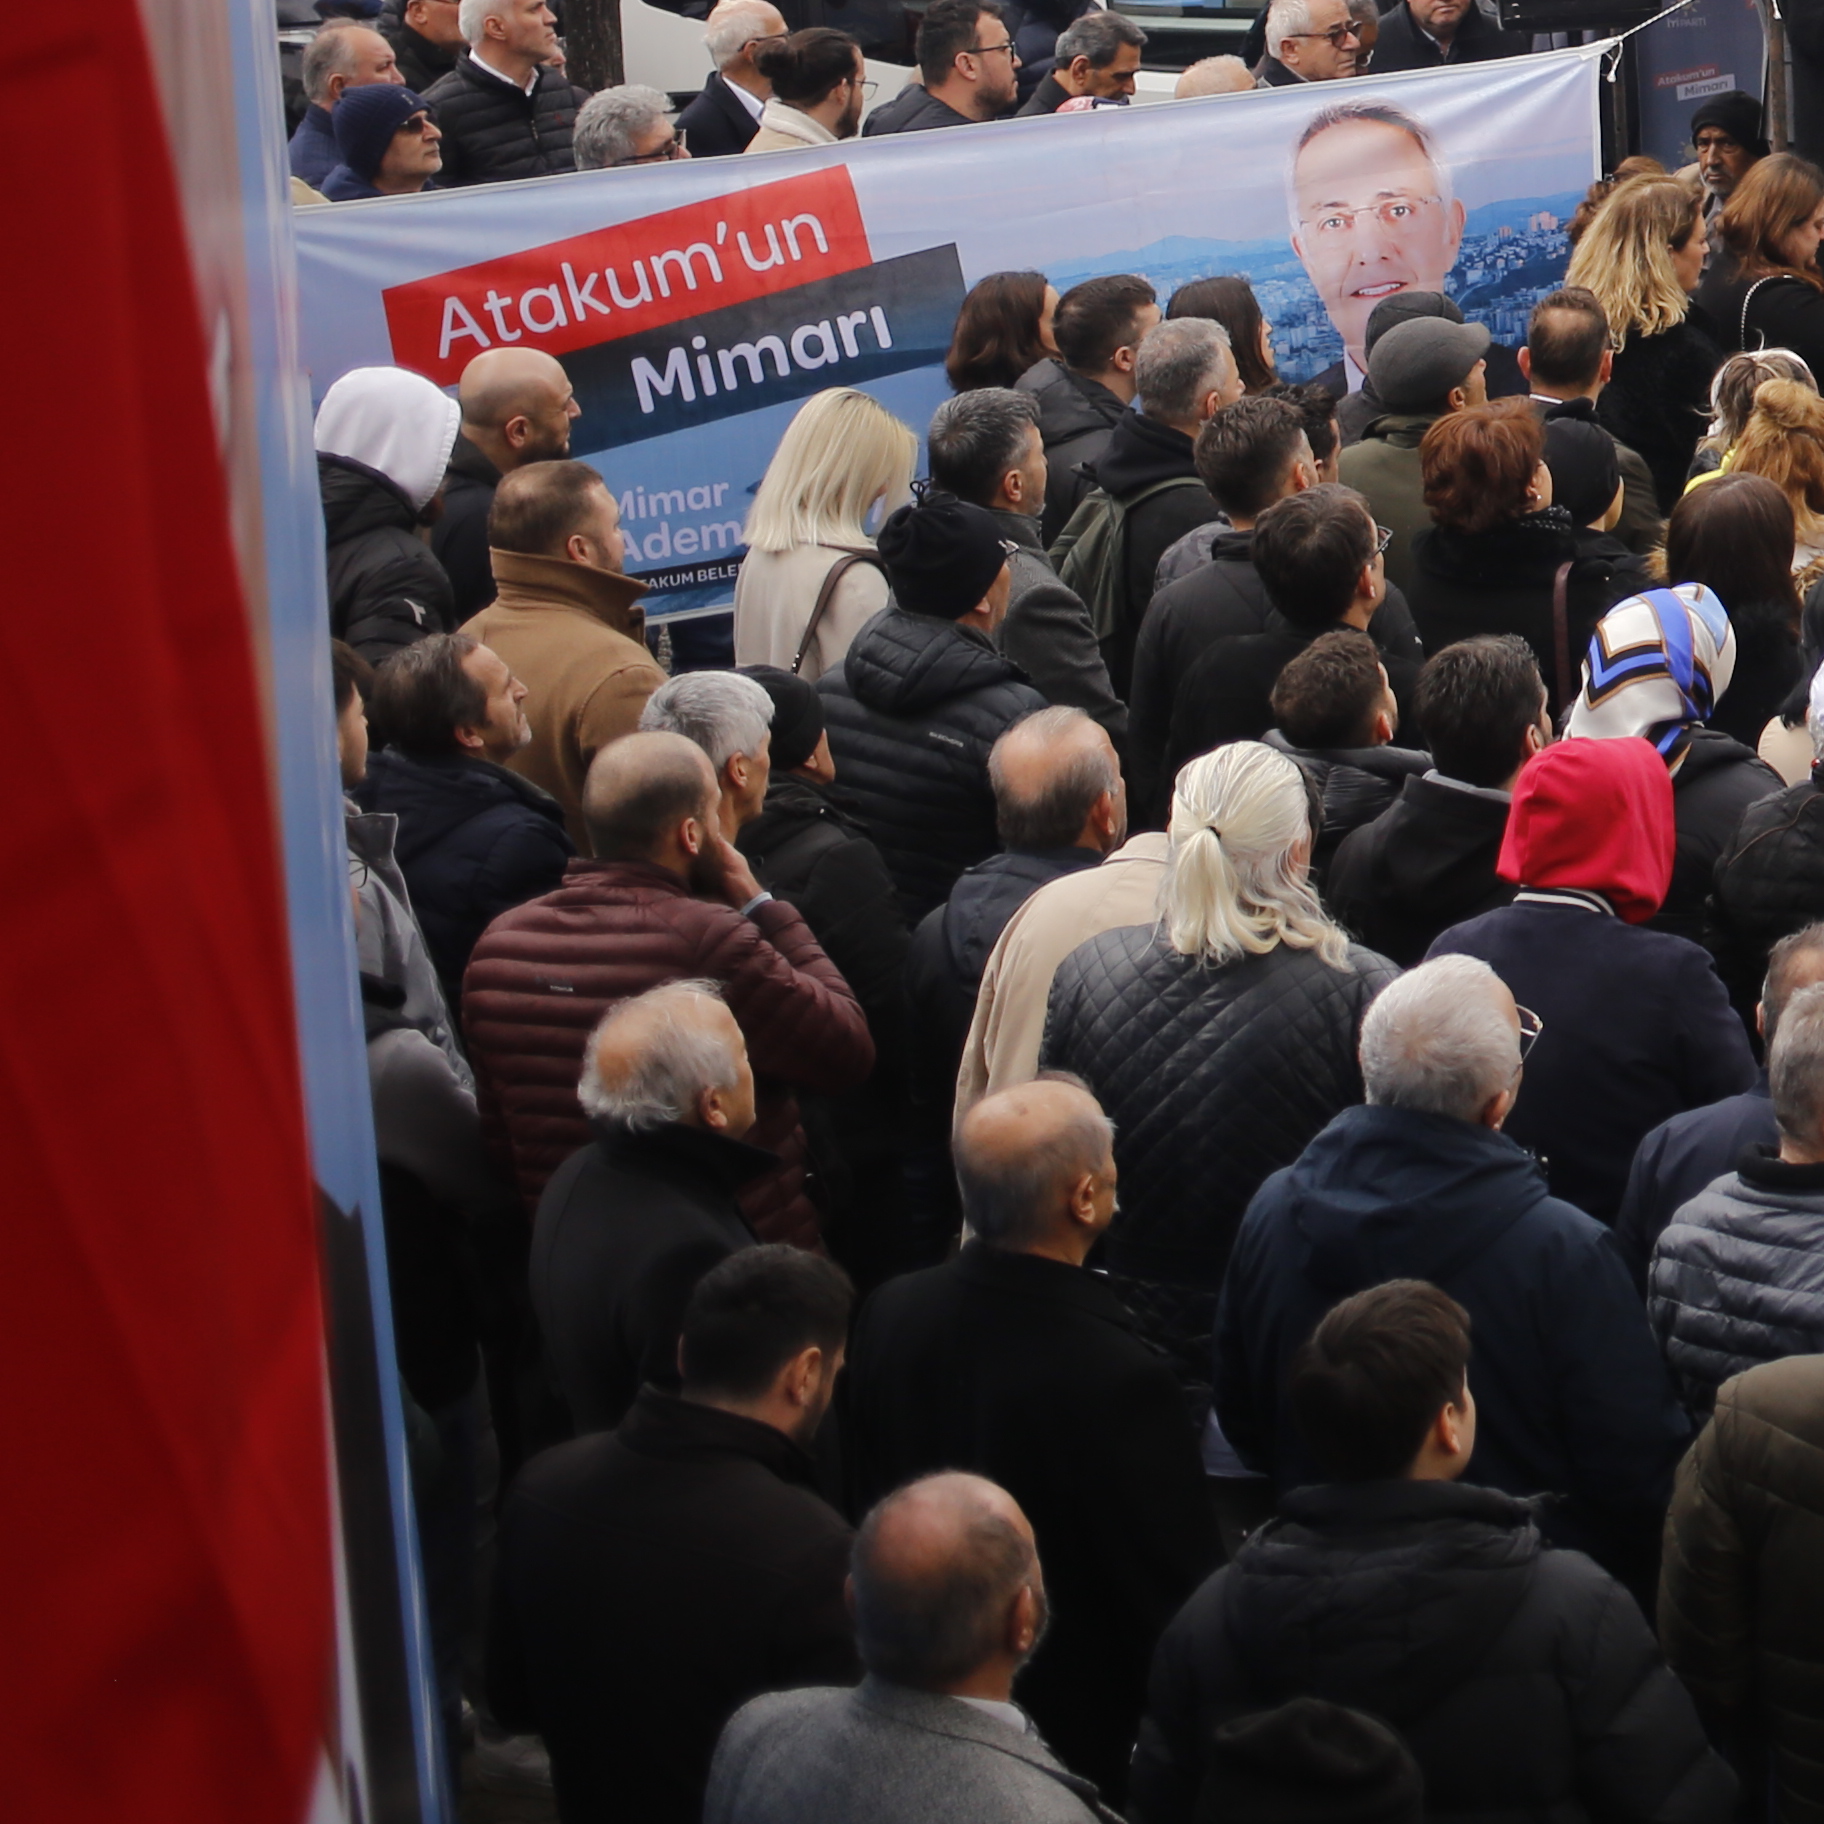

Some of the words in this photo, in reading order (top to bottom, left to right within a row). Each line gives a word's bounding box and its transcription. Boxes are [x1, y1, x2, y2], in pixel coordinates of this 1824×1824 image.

[1657, 67, 1715, 87] Atakum'un
[1684, 80, 1728, 96] Mimarı
[437, 211, 829, 359] Atakum'un
[630, 304, 893, 413] Mimarı
[619, 482, 729, 520] Mimar
[697, 563, 739, 583] BELE
